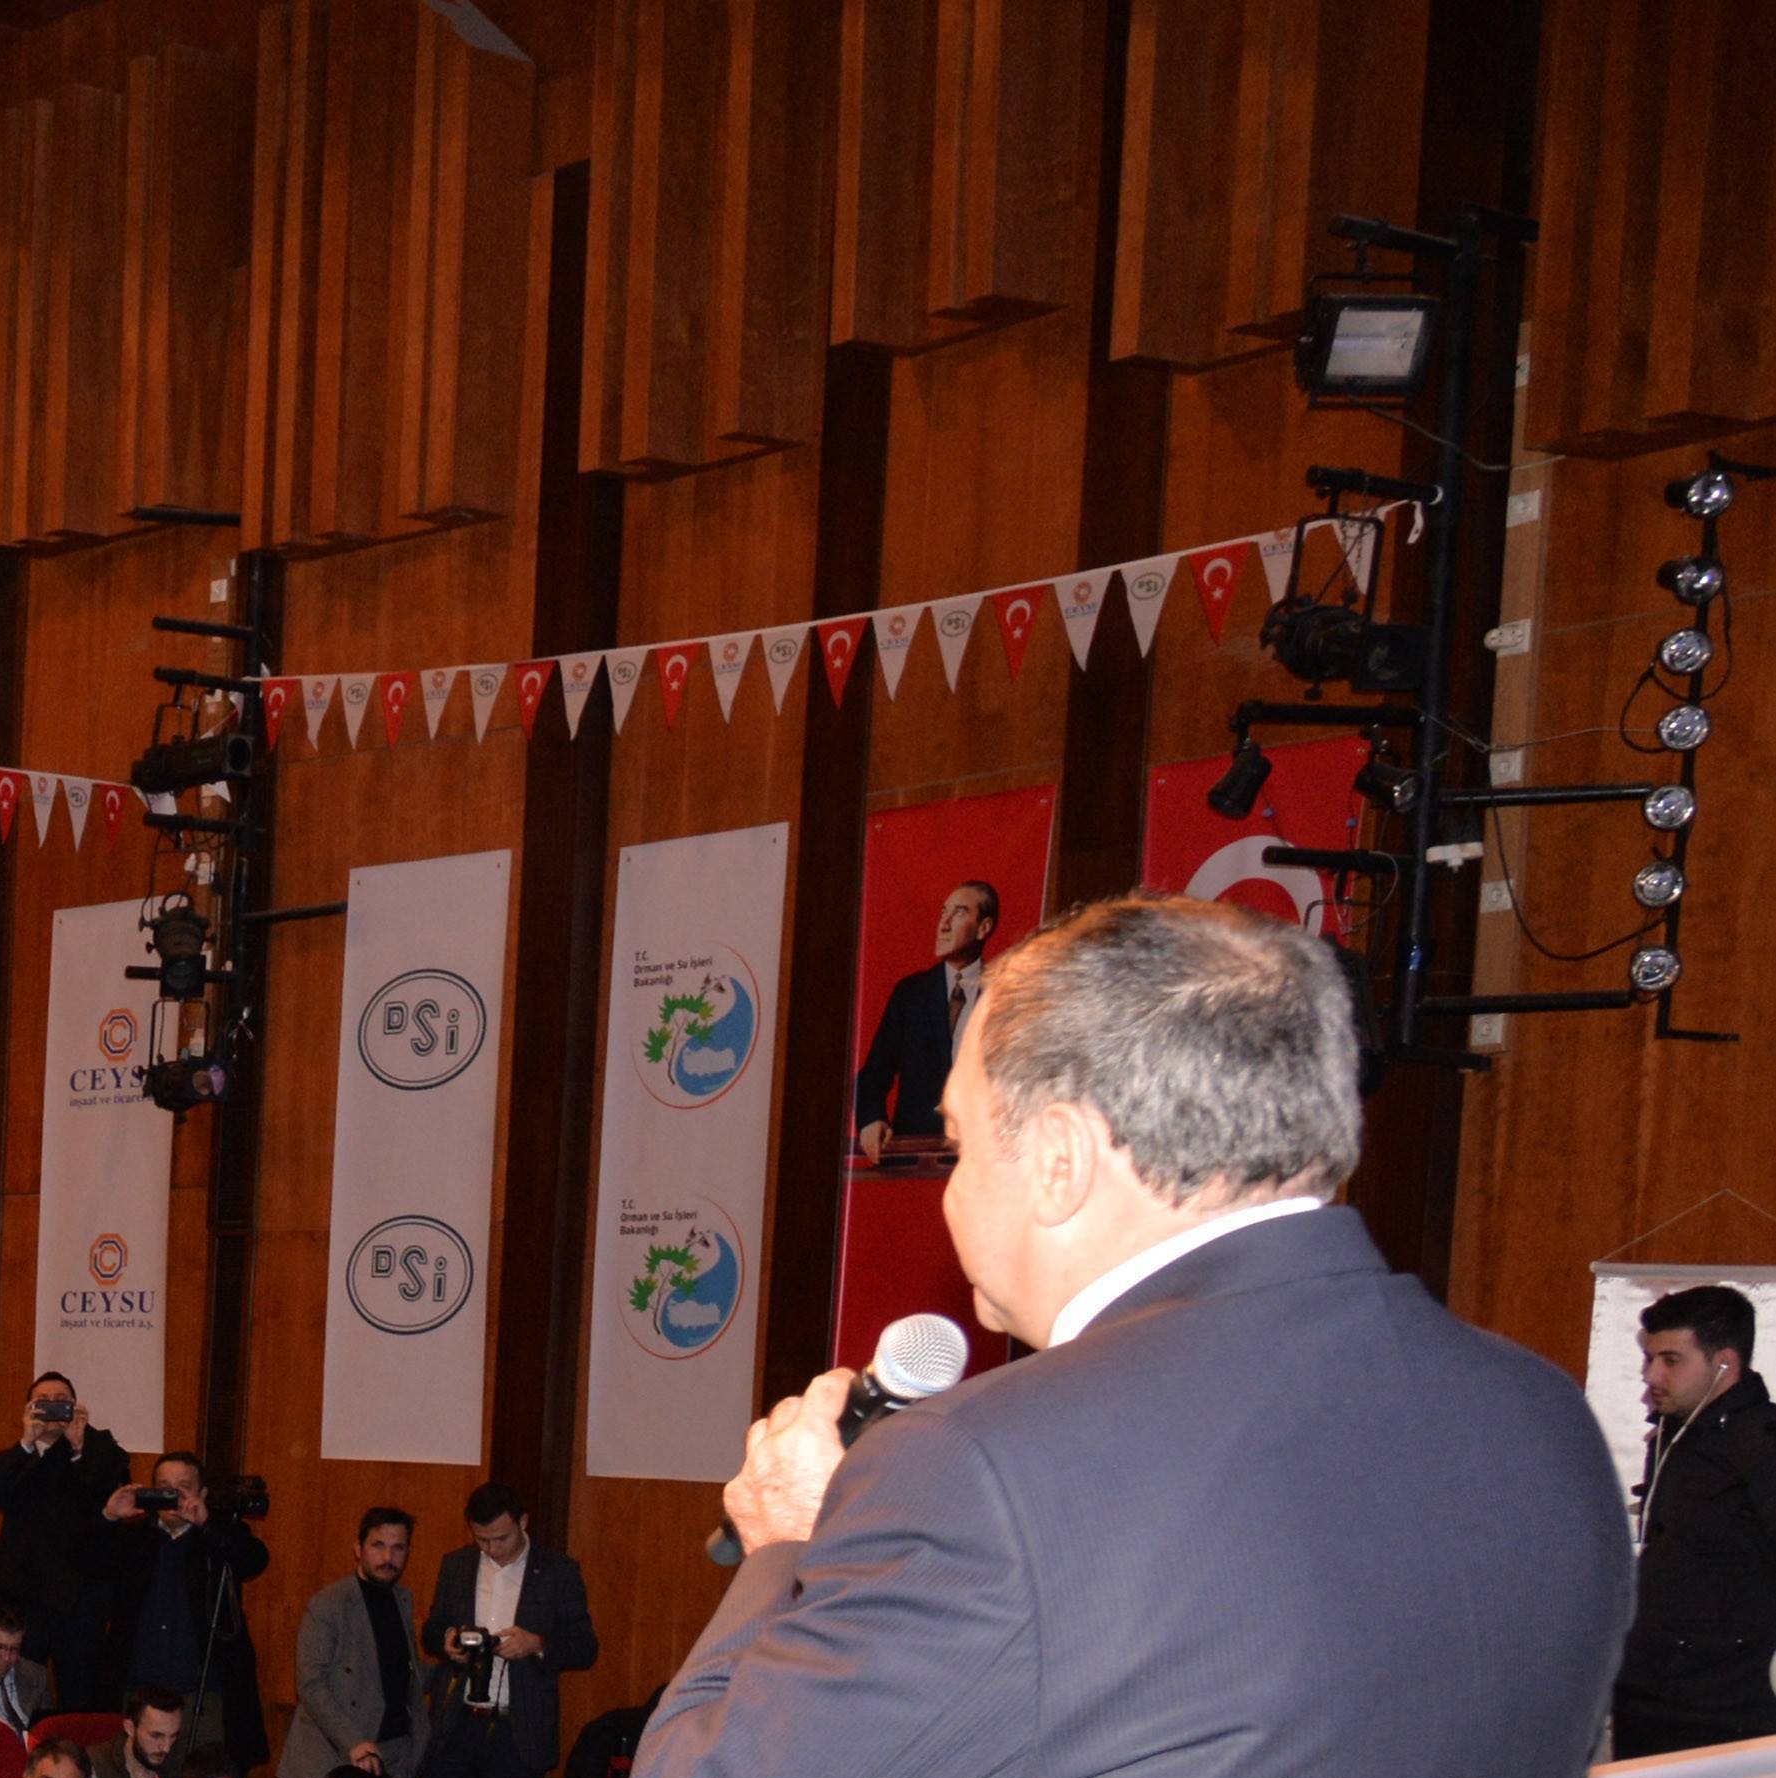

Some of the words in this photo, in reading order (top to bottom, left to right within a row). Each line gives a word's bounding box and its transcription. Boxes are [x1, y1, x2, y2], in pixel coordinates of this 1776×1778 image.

[69, 1064, 144, 1092] CEYS
[620, 1212, 648, 1222] Orman
[650, 1213, 660, 1221] ve
[662, 1210, 673, 1221] Su
[60, 1290, 156, 1314] CEYSU
